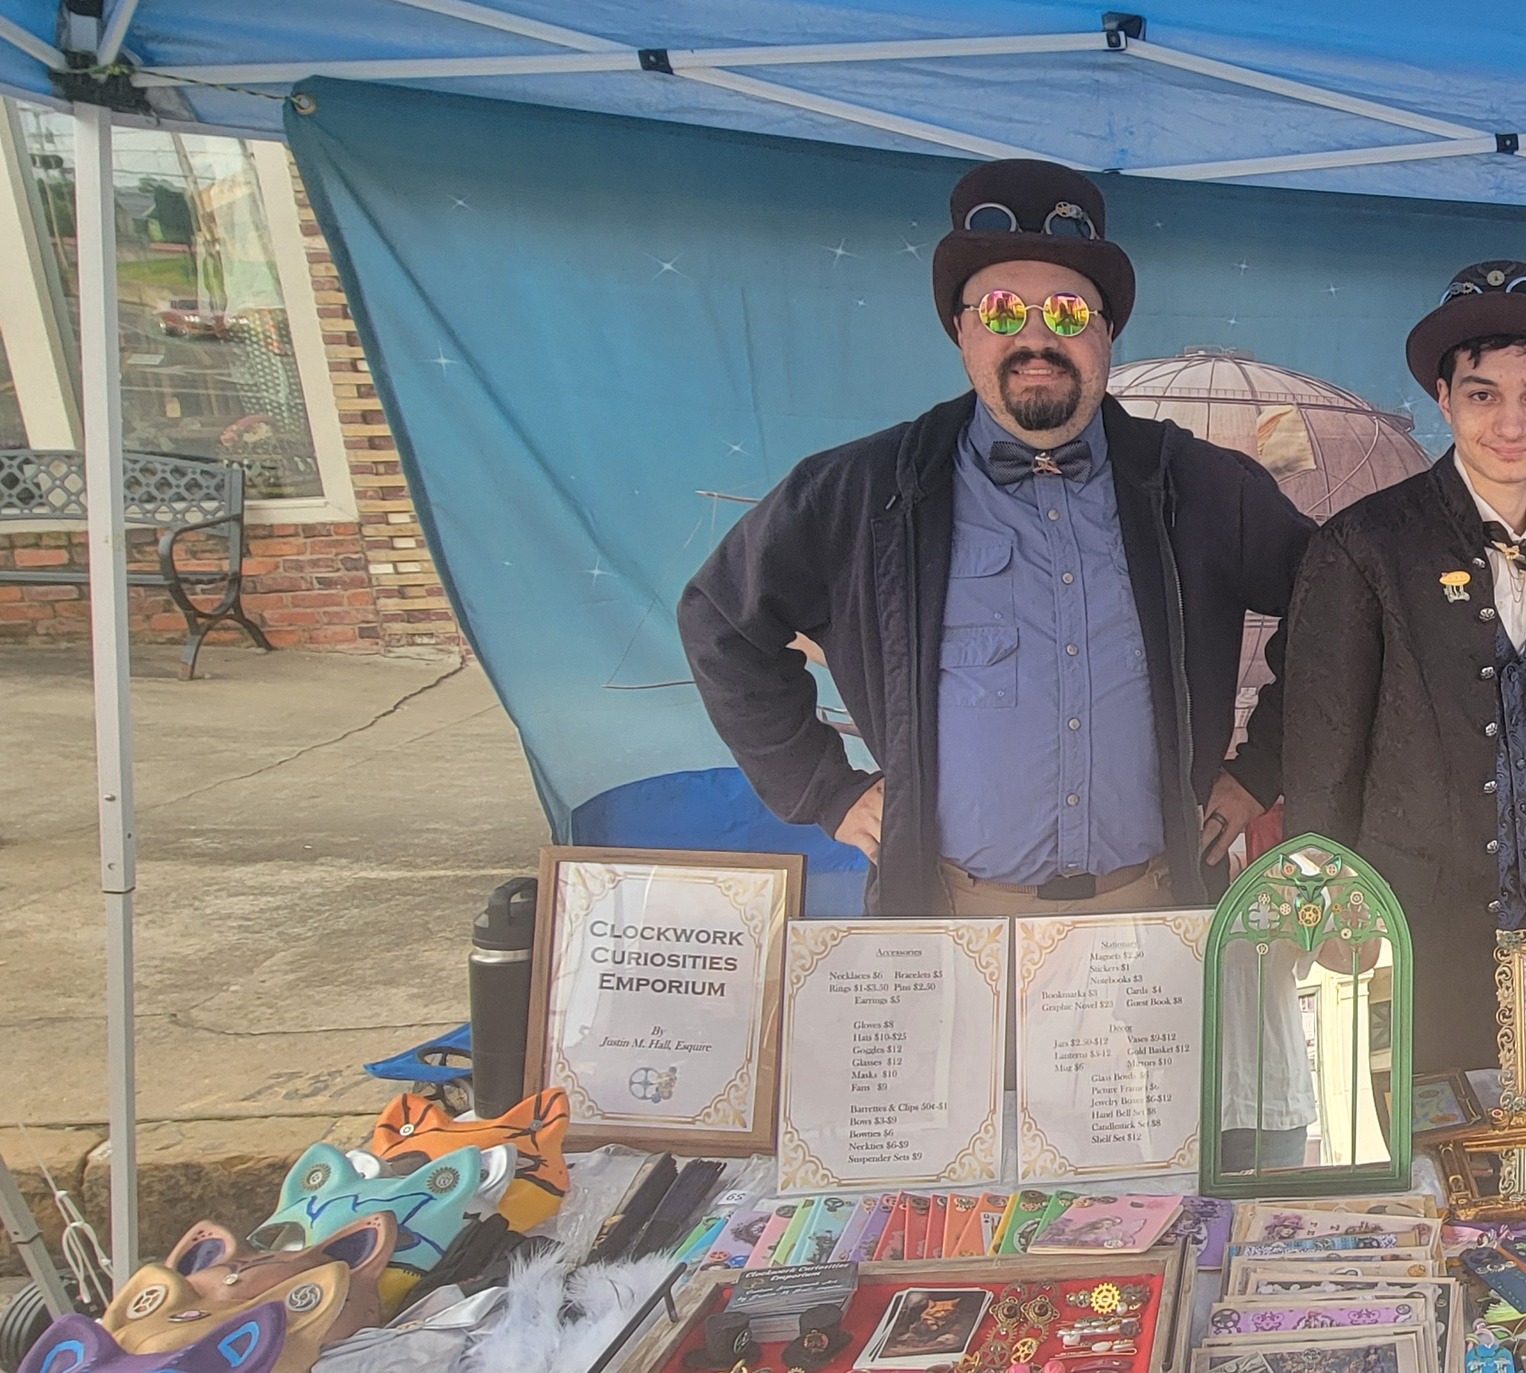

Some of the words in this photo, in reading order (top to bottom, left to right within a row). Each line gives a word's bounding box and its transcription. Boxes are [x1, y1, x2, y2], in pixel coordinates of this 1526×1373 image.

[589, 920, 745, 946] CLOCKWORK
[875, 948, 923, 957] Accessories
[590, 946, 738, 971] CURIOSITIES
[829, 971, 871, 980] Necklaces
[894, 971, 931, 979] Bracelets
[598, 972, 726, 997] EMPORIUM
[1090, 976, 1131, 984] Notebooks
[829, 984, 852, 993] Rings
[893, 983, 911, 991] Pins
[1126, 986, 1149, 995] Cards
[1042, 990, 1086, 999] Bookmarks
[854, 996, 888, 1005] Earrings
[1126, 999, 1149, 1008] Guest
[1150, 997, 1172, 1006] Book
[1075, 1001, 1097, 1010] Novel
[853, 1020, 882, 1029] Gloves
[650, 1026, 666, 1037] By
[853, 1033, 872, 1042] Hats
[599, 1036, 630, 1048] Justin
[631, 1038, 646, 1048] M.
[675, 1041, 713, 1052] Esquire
[852, 1046, 885, 1055] Goggles
[1148, 1046, 1174, 1055] Basket
[1175, 1044, 1190, 1053] $12
[1054, 1051, 1088, 1060] Lanterns
[852, 1058, 882, 1067] Glasses
[851, 1070, 877, 1079] Masks
[851, 1083, 870, 1092] Fans
[888, 1103, 896, 1112] &
[897, 1103, 919, 1113] Clips
[1091, 1110, 1113, 1119] Hand
[1116, 1109, 1131, 1118] Bell
[849, 1117, 872, 1126] Bows
[1091, 1121, 1135, 1131] Candlestick
[849, 1129, 882, 1138] Bowties
[1091, 1134, 1111, 1143] Shelf
[1113, 1134, 1125, 1142] Set
[848, 1141, 884, 1151] Neckties
[848, 1153, 892, 1164] Suspender
[893, 1153, 910, 1161] Sets
[911, 1152, 923, 1160] $9
